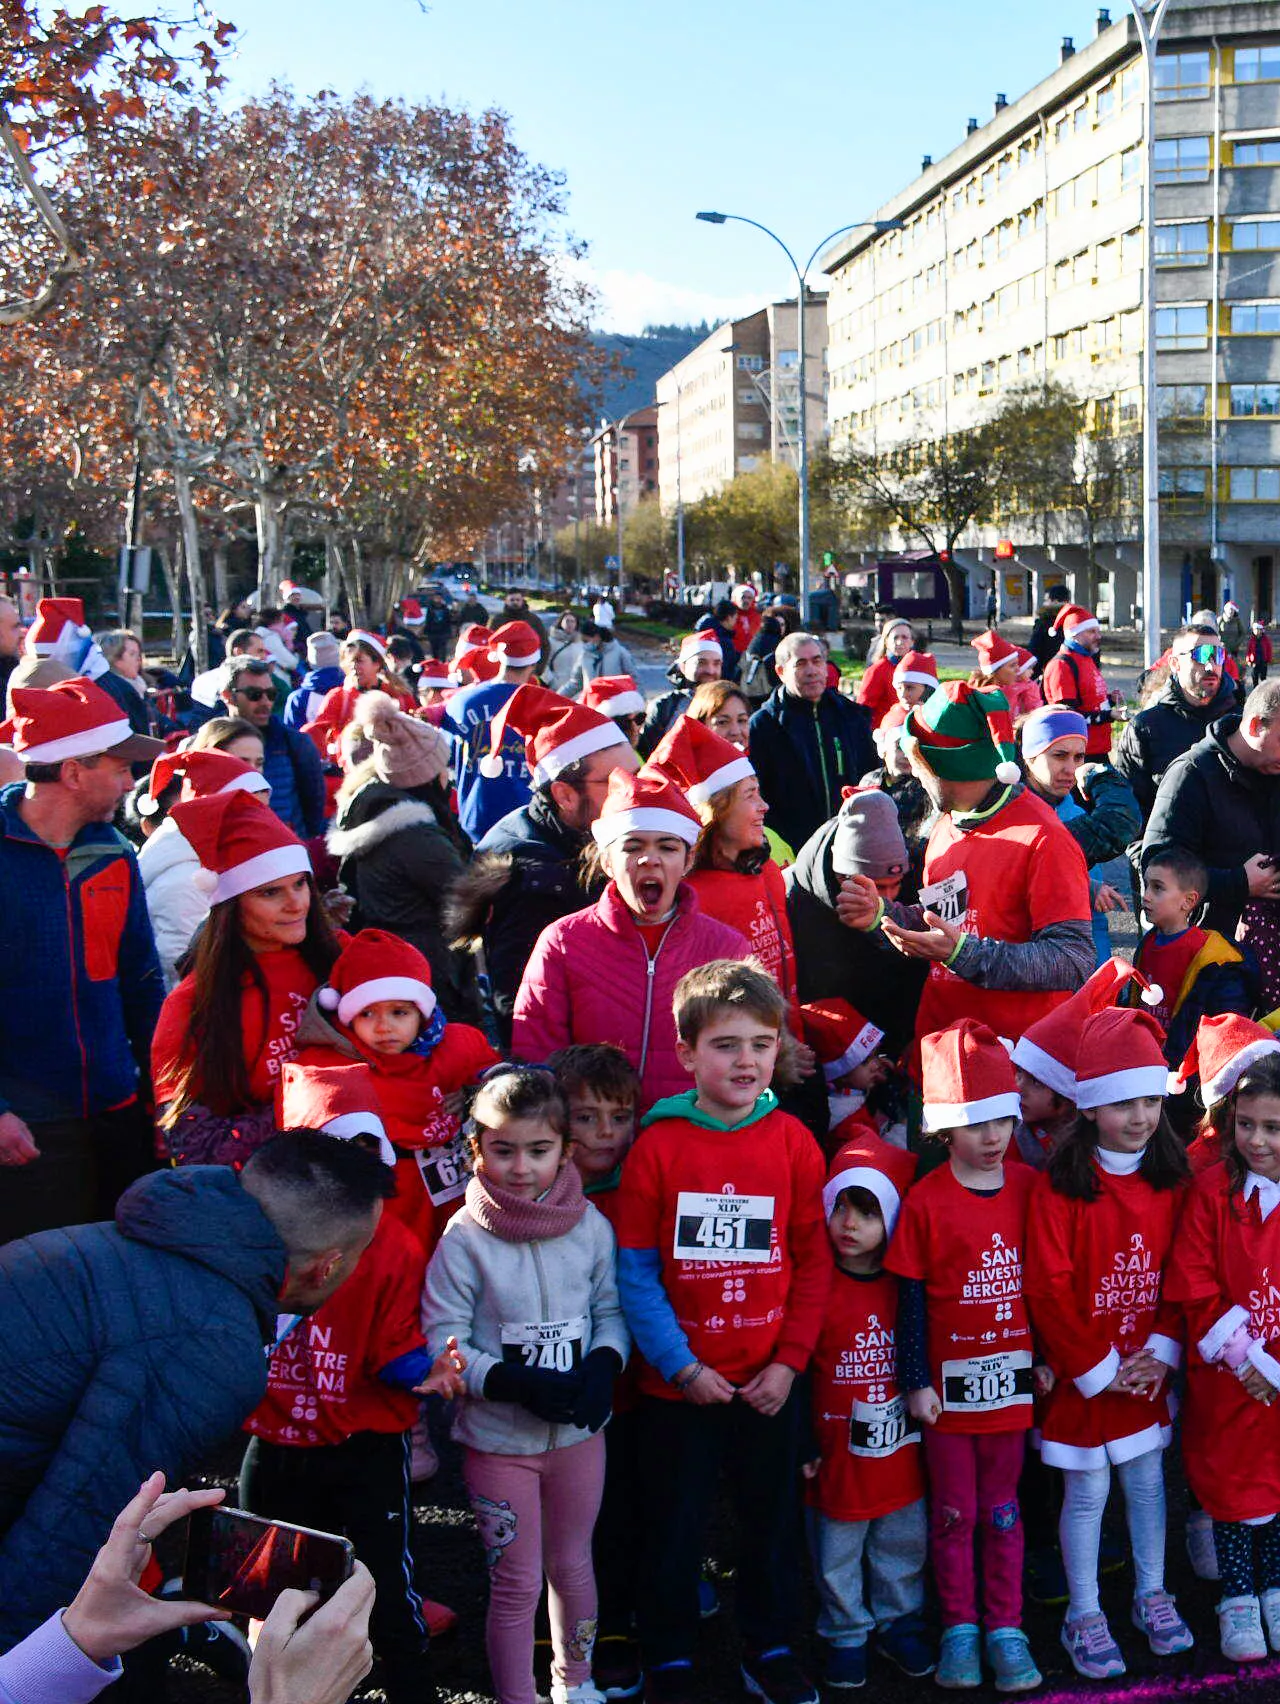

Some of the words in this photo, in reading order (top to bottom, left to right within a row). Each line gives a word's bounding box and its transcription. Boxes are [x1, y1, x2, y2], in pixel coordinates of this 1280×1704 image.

[718, 1203, 741, 1213] XLIV
[695, 1216, 747, 1249] 451
[981, 1246, 1018, 1268] SAN
[1113, 1250, 1151, 1272] SAN
[538, 1329, 562, 1339] XLIV
[855, 1330, 895, 1349] SAN
[521, 1341, 574, 1373] 240
[980, 1361, 1003, 1372] XLIV
[963, 1369, 1016, 1403] 303
